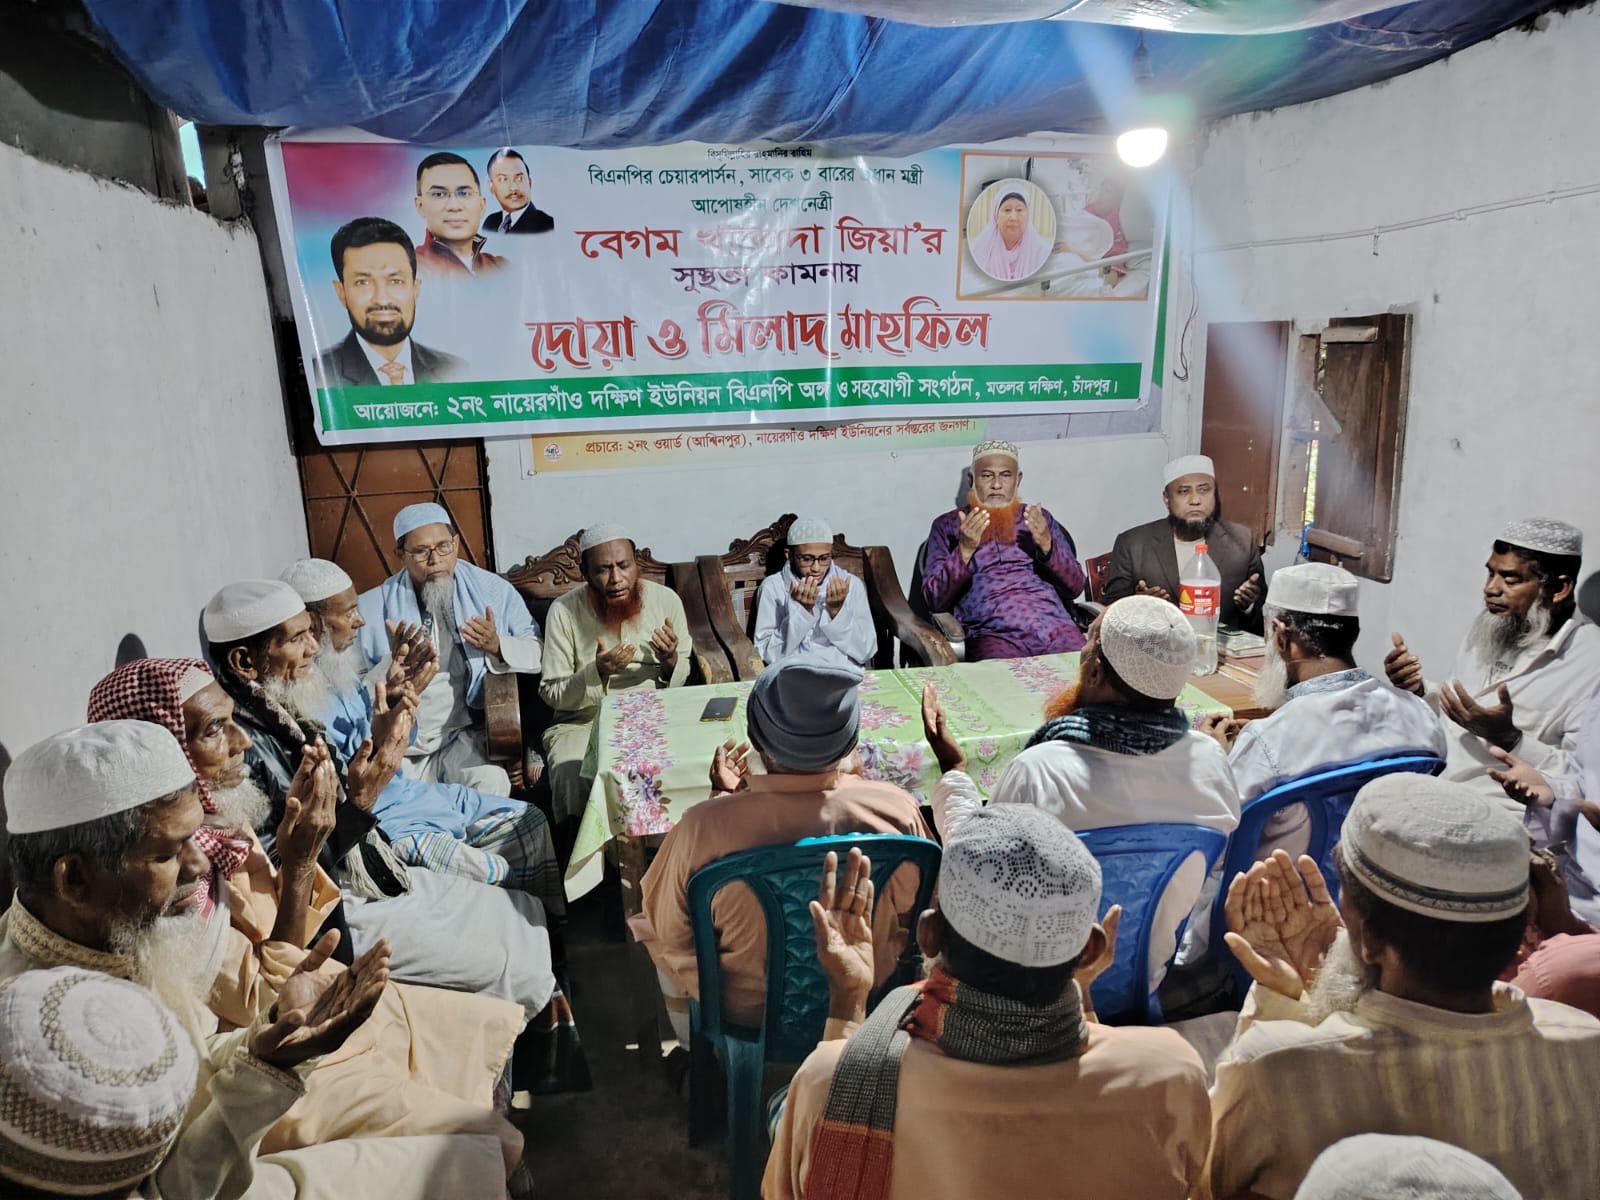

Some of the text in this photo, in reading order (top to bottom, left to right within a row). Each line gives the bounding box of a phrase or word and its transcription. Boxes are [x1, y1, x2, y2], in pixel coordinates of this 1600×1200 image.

[588, 163, 653, 185] বিএনপির
[748, 166, 794, 183] সাবেক
[800, 169, 812, 181] ৩
[817, 166, 856, 182] বারের
[900, 163, 924, 185] মন্ত্রী
[574, 225, 682, 259] বেগম
[671, 261, 862, 292] সুস্থতা কামনায়
[523, 294, 991, 371] দোয়া ও মিলাদ মাহফিল
[446, 395, 487, 420] ২নং
[493, 383, 583, 416] নায়েরগাঁও
[588, 384, 642, 412] দক্ষিণ
[647, 380, 721, 408] ইউনিয়ন
[726, 376, 792, 405] বিএনপি
[798, 382, 829, 403] অঙ্গ
[838, 382, 849, 399] ও
[851, 371, 914, 399] সহযোগী
[918, 370, 981, 401] সংগঠন,
[986, 380, 1024, 396] মতলব
[1028, 375, 1068, 398] দক্ষিণ,
[627, 439, 649, 453] ২নং
[653, 434, 683, 450] ওয়ার্ড
[809, 424, 837, 441] দক্ষিণ
[840, 423, 892, 440] ইউনিয়নের
[896, 419, 936, 437] সর্বস্তরের
